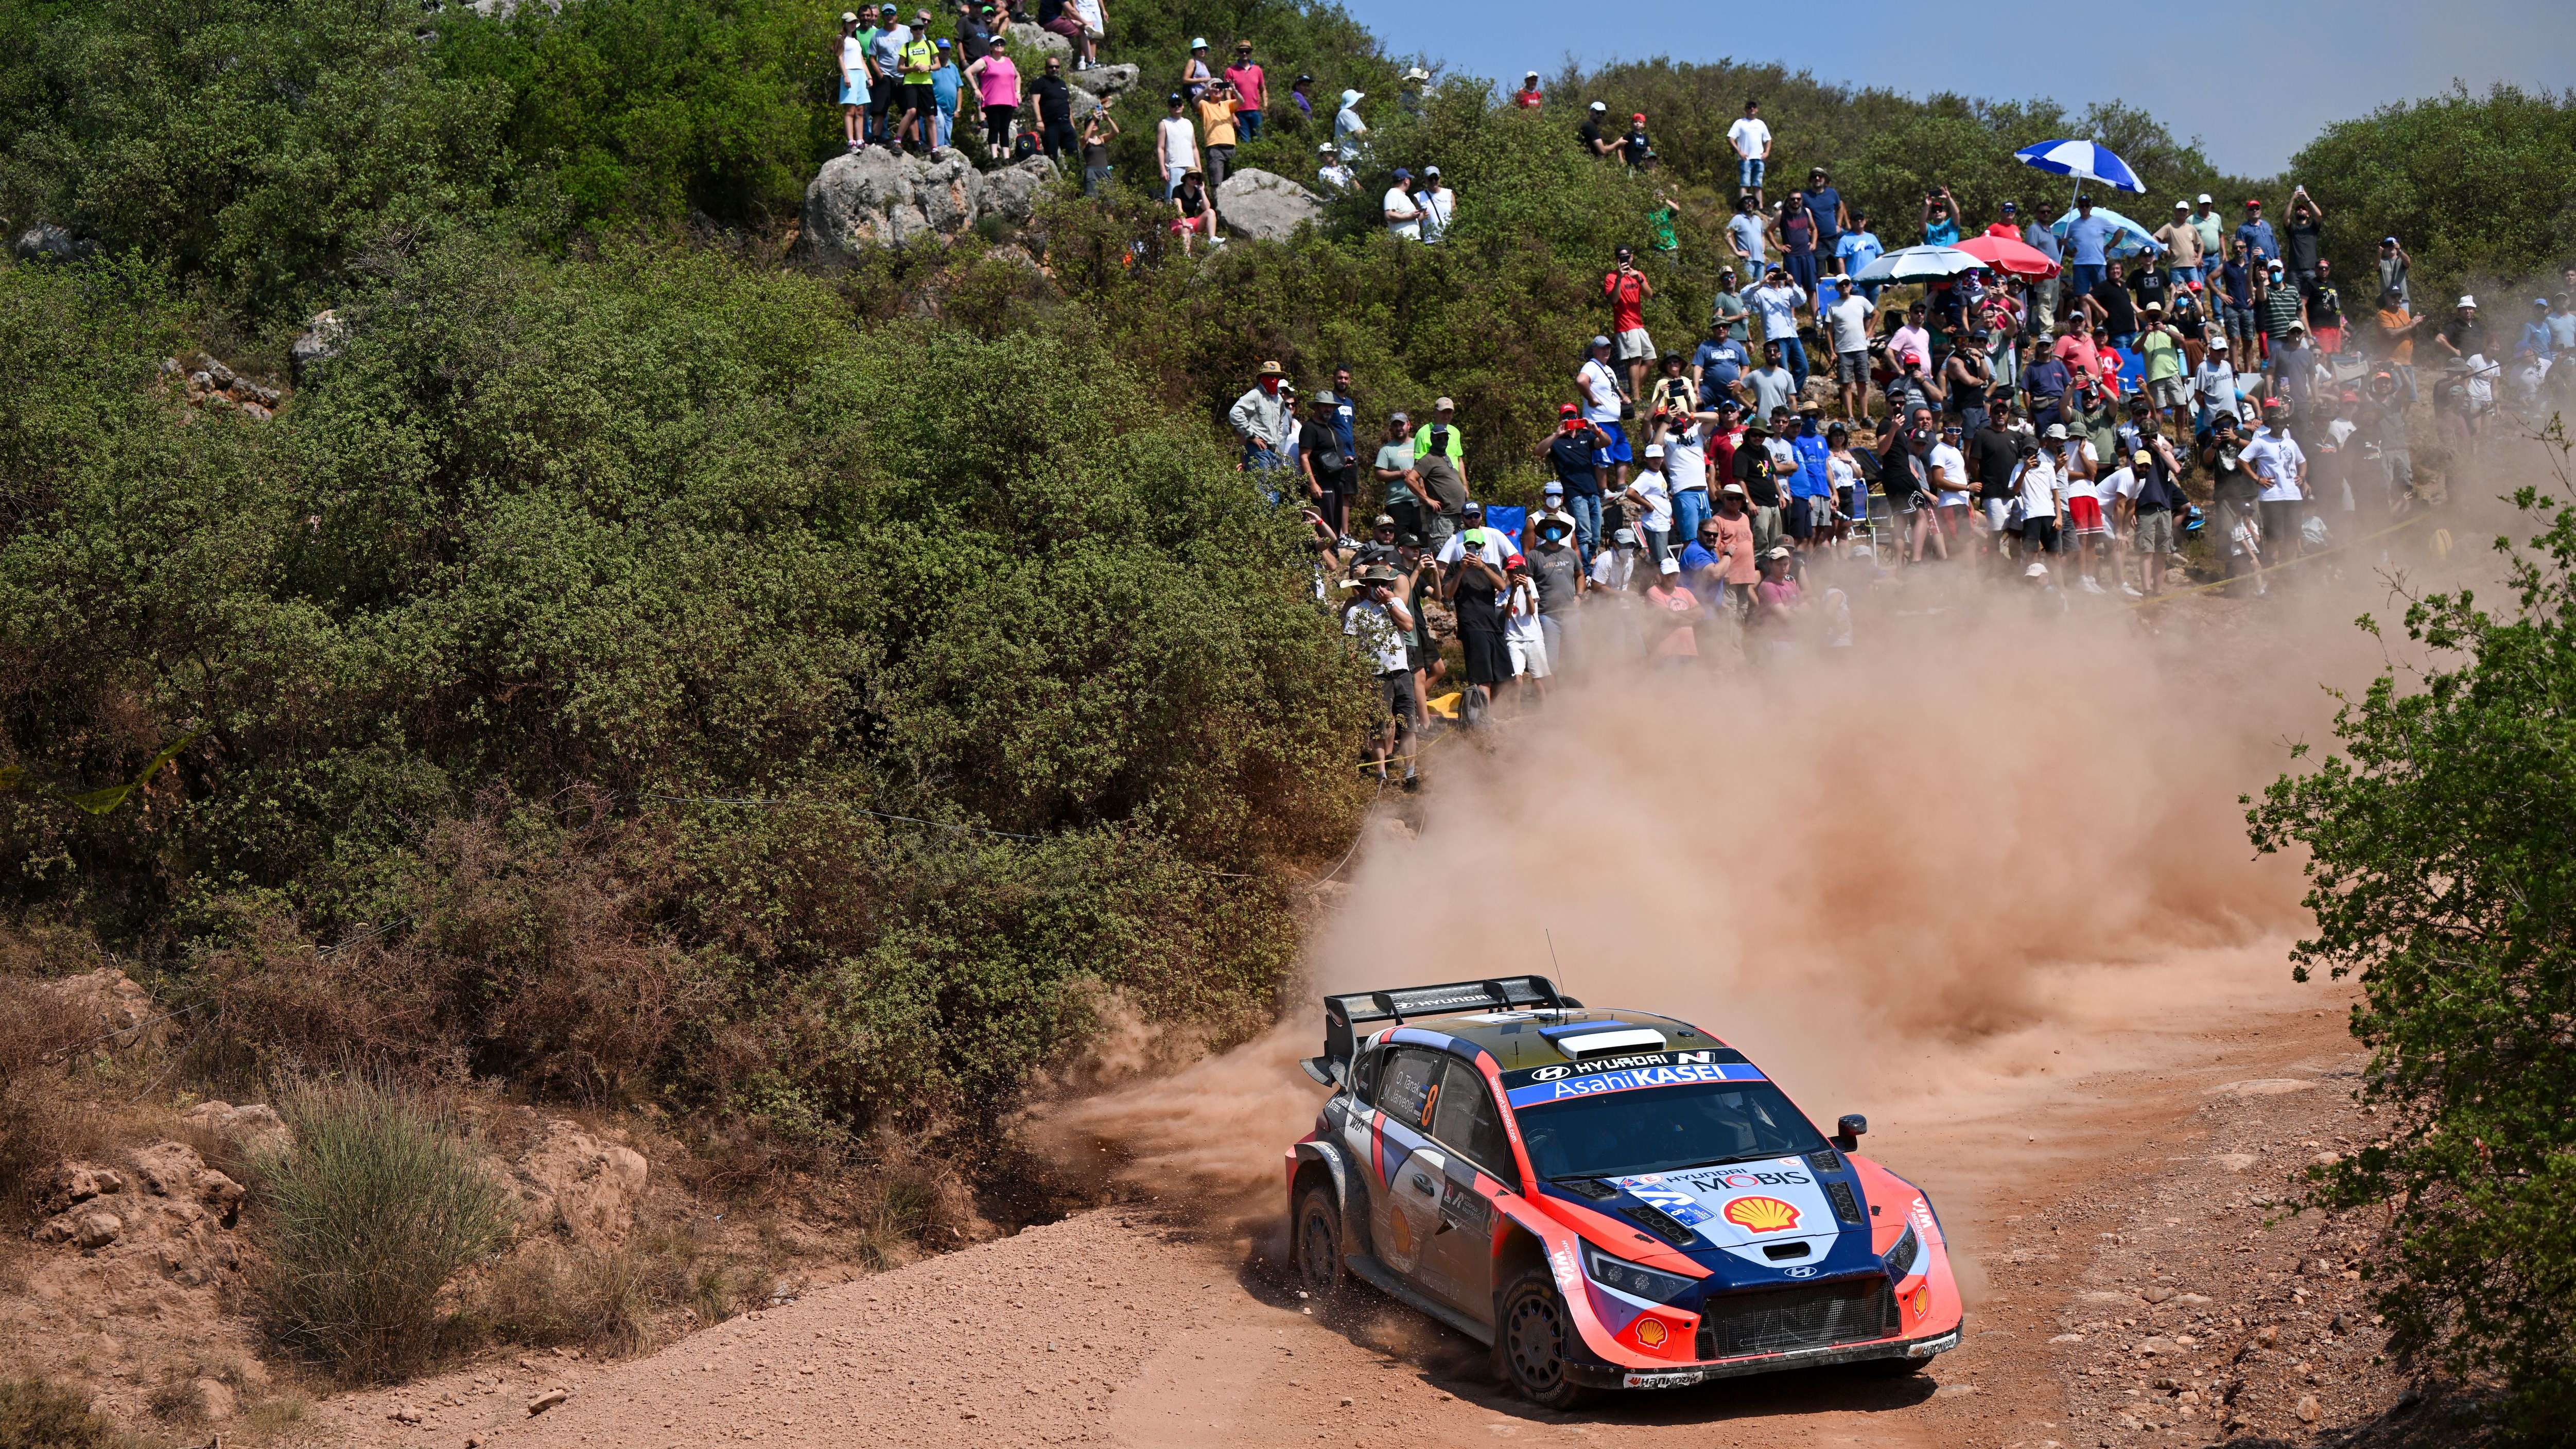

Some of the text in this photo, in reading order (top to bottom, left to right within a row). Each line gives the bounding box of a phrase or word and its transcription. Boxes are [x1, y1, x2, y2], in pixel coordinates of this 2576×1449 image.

[1774, 452, 1786, 461] NIKE
[1418, 994, 1492, 1006] HYUNDAI
[1575, 1054, 1668, 1074] HYUNDAI
[1396, 1071, 1420, 1095] O. Tänak
[1555, 1065, 1727, 1098] AsahiKASEI
[1330, 1102, 1341, 1113] STEEL
[1383, 1084, 1390, 1099] M.
[1390, 1089, 1414, 1114] Järveoja
[1421, 1084, 1438, 1126] 8
[1489, 1076, 1517, 1144] motorsport.hyundai.com
[1666, 1168, 1748, 1183] HYUNDAI
[1692, 1171, 1811, 1193] MOBIS
[1911, 1212, 1926, 1240] HYUNDAI
[1561, 1239, 1577, 1267] HYUNDAI
